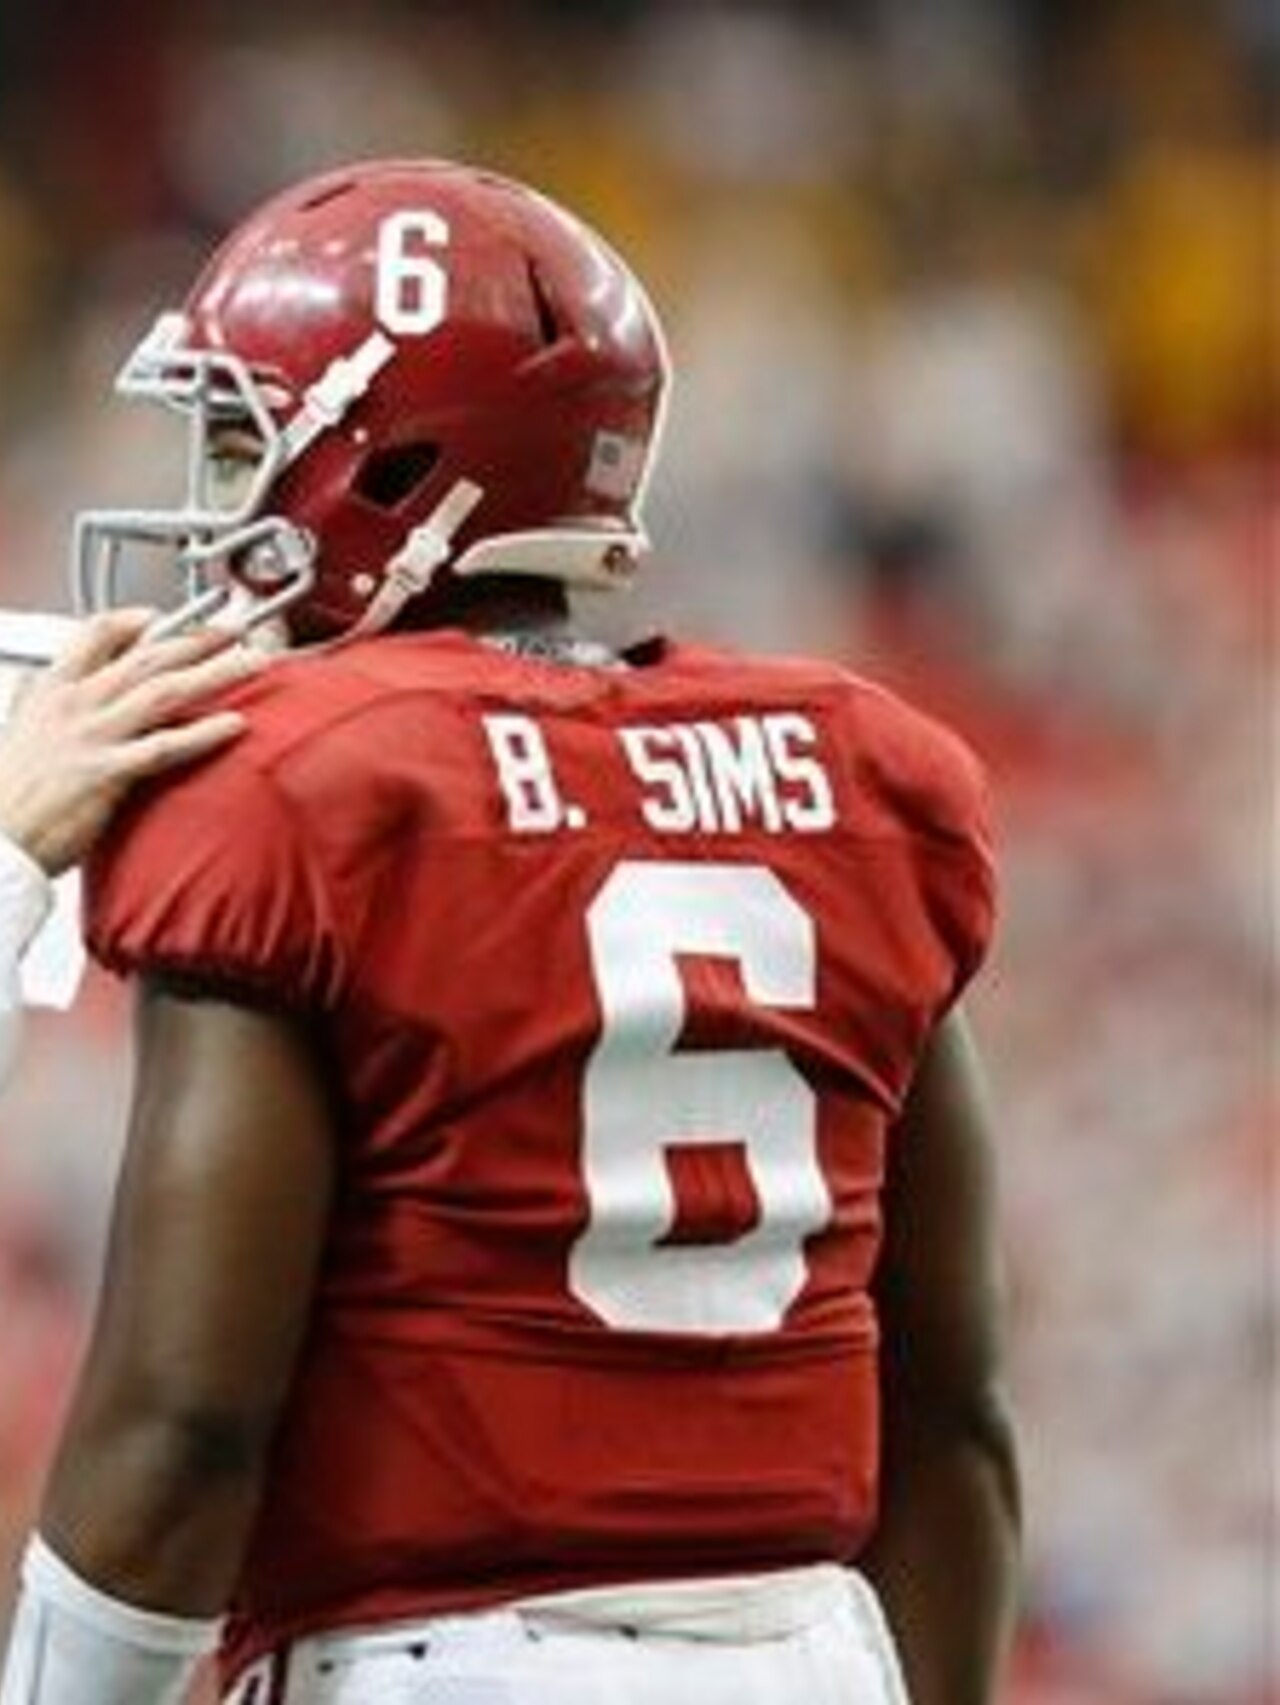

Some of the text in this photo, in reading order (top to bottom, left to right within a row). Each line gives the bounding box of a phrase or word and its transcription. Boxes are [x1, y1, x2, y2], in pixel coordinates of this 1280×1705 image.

[376, 210, 449, 335] 6
[484, 712, 837, 833] B. SIMS
[569, 860, 831, 1335] 6
